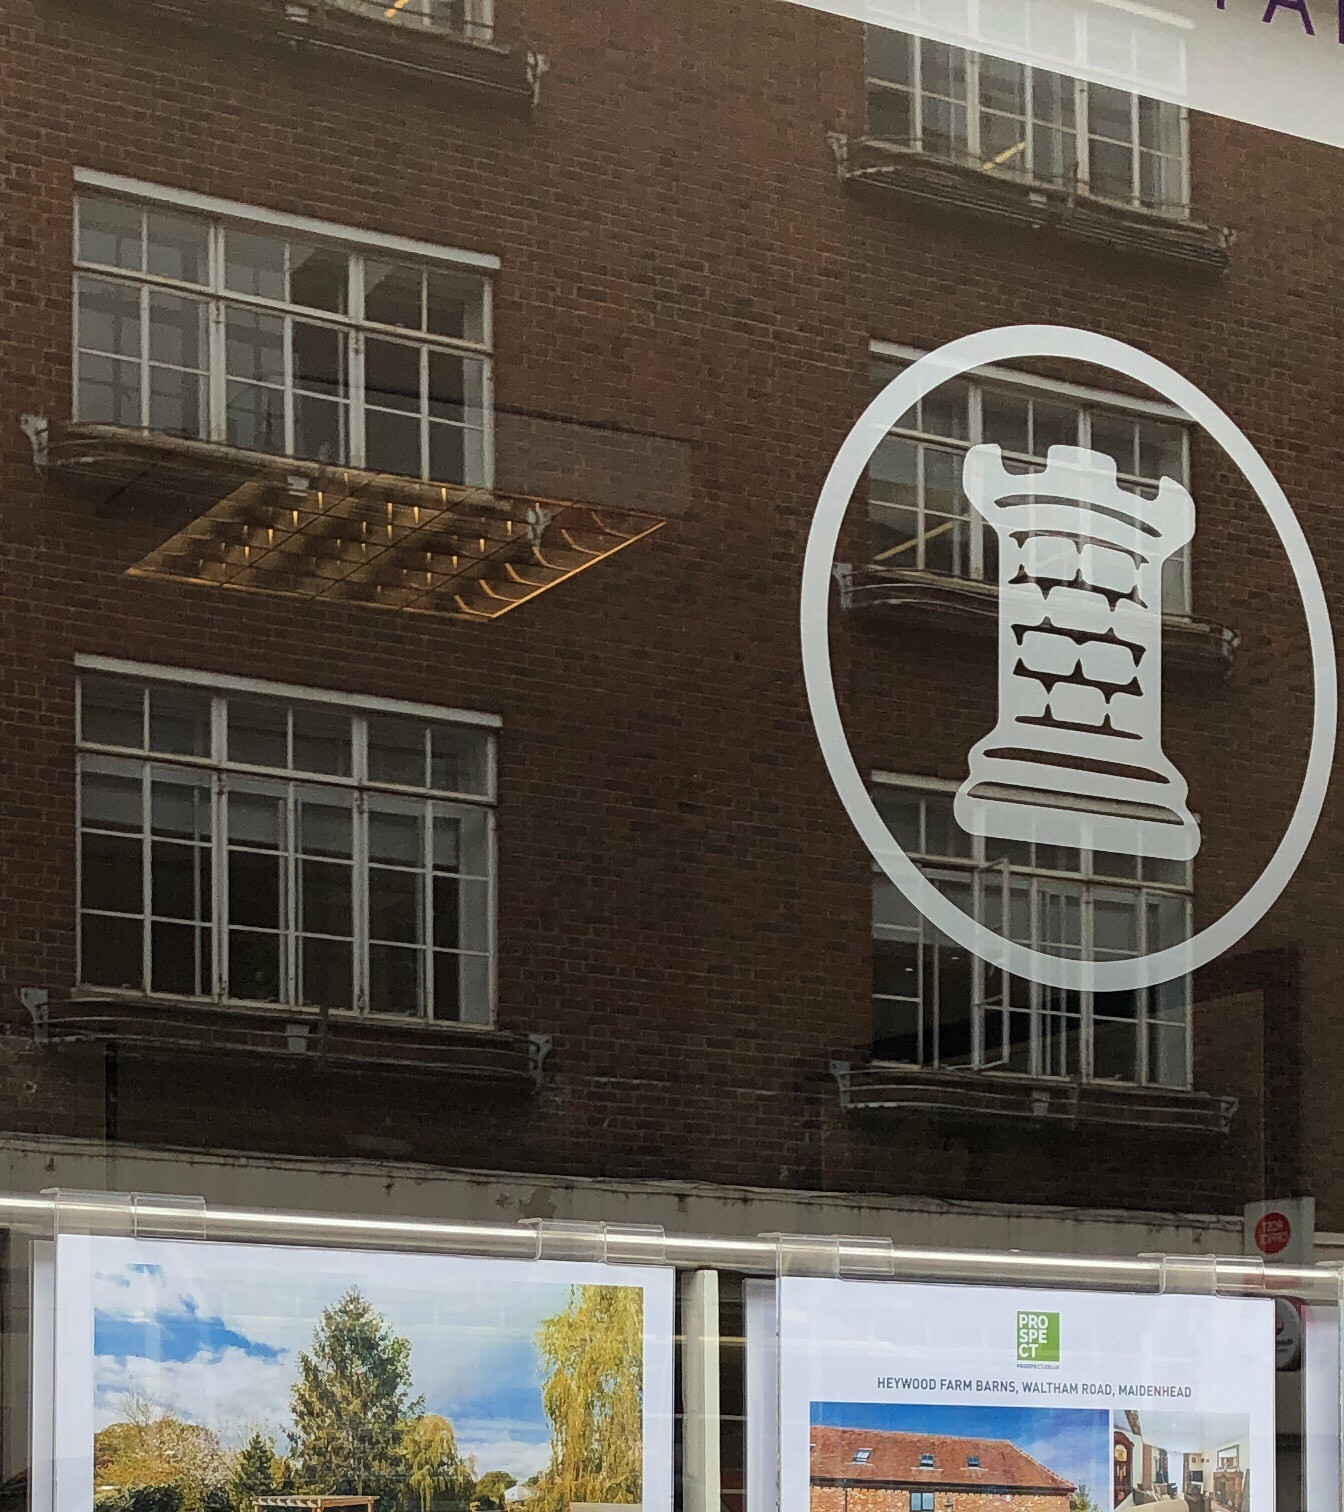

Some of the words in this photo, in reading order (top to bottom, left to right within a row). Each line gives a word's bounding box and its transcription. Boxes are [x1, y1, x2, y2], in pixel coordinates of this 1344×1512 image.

[1019, 1314, 1049, 1329] PRO
[1019, 1329, 1047, 1344] SPE
[1019, 1344, 1038, 1359] CT
[877, 1377, 937, 1391] HEYWOOD
[940, 1379, 972, 1392] FARM
[976, 1380, 1019, 1394] BARNS,
[1022, 1381, 1078, 1394] WALTHAM
[1082, 1383, 1115, 1397] ROAD,
[1118, 1384, 1192, 1398] MAIDENHEAD
